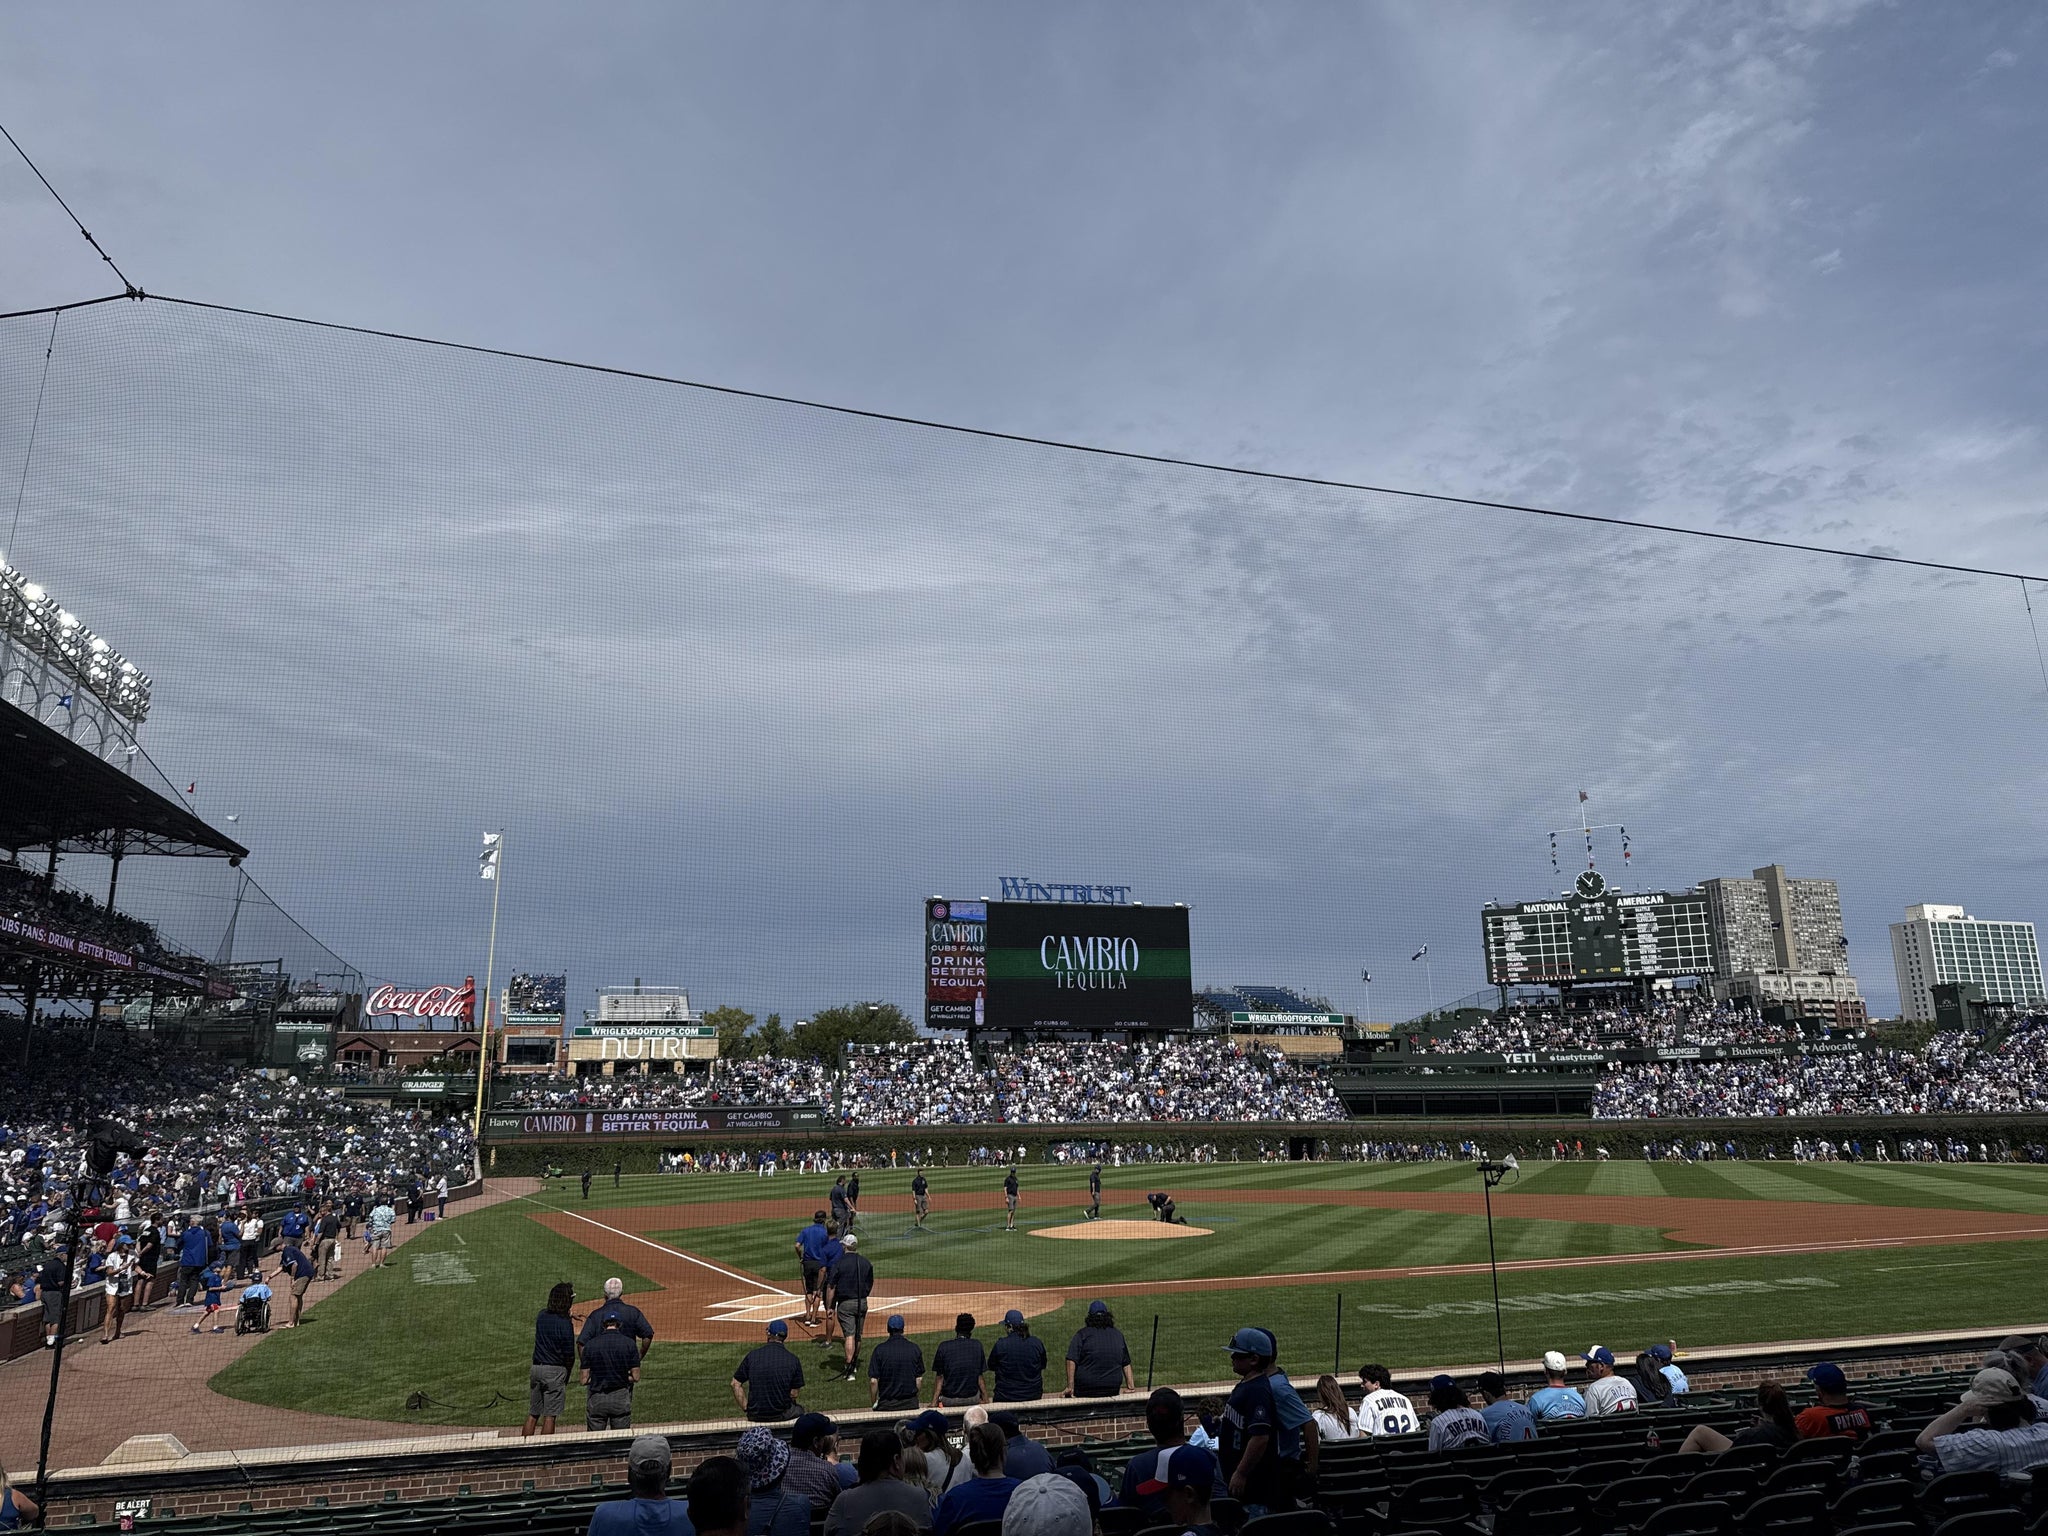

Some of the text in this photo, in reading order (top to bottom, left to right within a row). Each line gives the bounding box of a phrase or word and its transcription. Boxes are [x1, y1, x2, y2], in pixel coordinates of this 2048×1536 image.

[998, 876, 1131, 904] WINTRUST
[1617, 895, 1664, 906] AMERICAN
[1523, 902, 1569, 913] NATIONAL
[932, 924, 984, 943] CAMBIO
[21, 923, 47, 943] FANS:
[48, 932, 74, 951] DRINK
[78, 941, 103, 960] BETTER
[105, 948, 132, 967] TEQUILA
[1040, 935, 1139, 972] CAMBIO
[931, 956, 985, 966] DRINK
[931, 967, 985, 976] BETTER
[931, 978, 985, 987] TEQUILA
[1055, 971, 1127, 991] TEQUILA
[365, 985, 471, 1018] Coca-Cola
[1657, 1047, 1700, 1055] GRAINGER
[1732, 1046, 1784, 1056] Budweiser
[1812, 1042, 1858, 1052] Advocate
[1502, 1053, 1604, 1064] YETI tastytrade
[401, 1081, 445, 1089] GRAINGER
[602, 1112, 697, 1121] CUBS FANS: DRINK
[744, 1112, 773, 1120] CAMBIO
[489, 1118, 520, 1127] Harvey
[524, 1115, 576, 1133] CAMBIO
[602, 1120, 710, 1132] BETTER TEQUILA
[116, 1500, 150, 1510] BE ALERT
